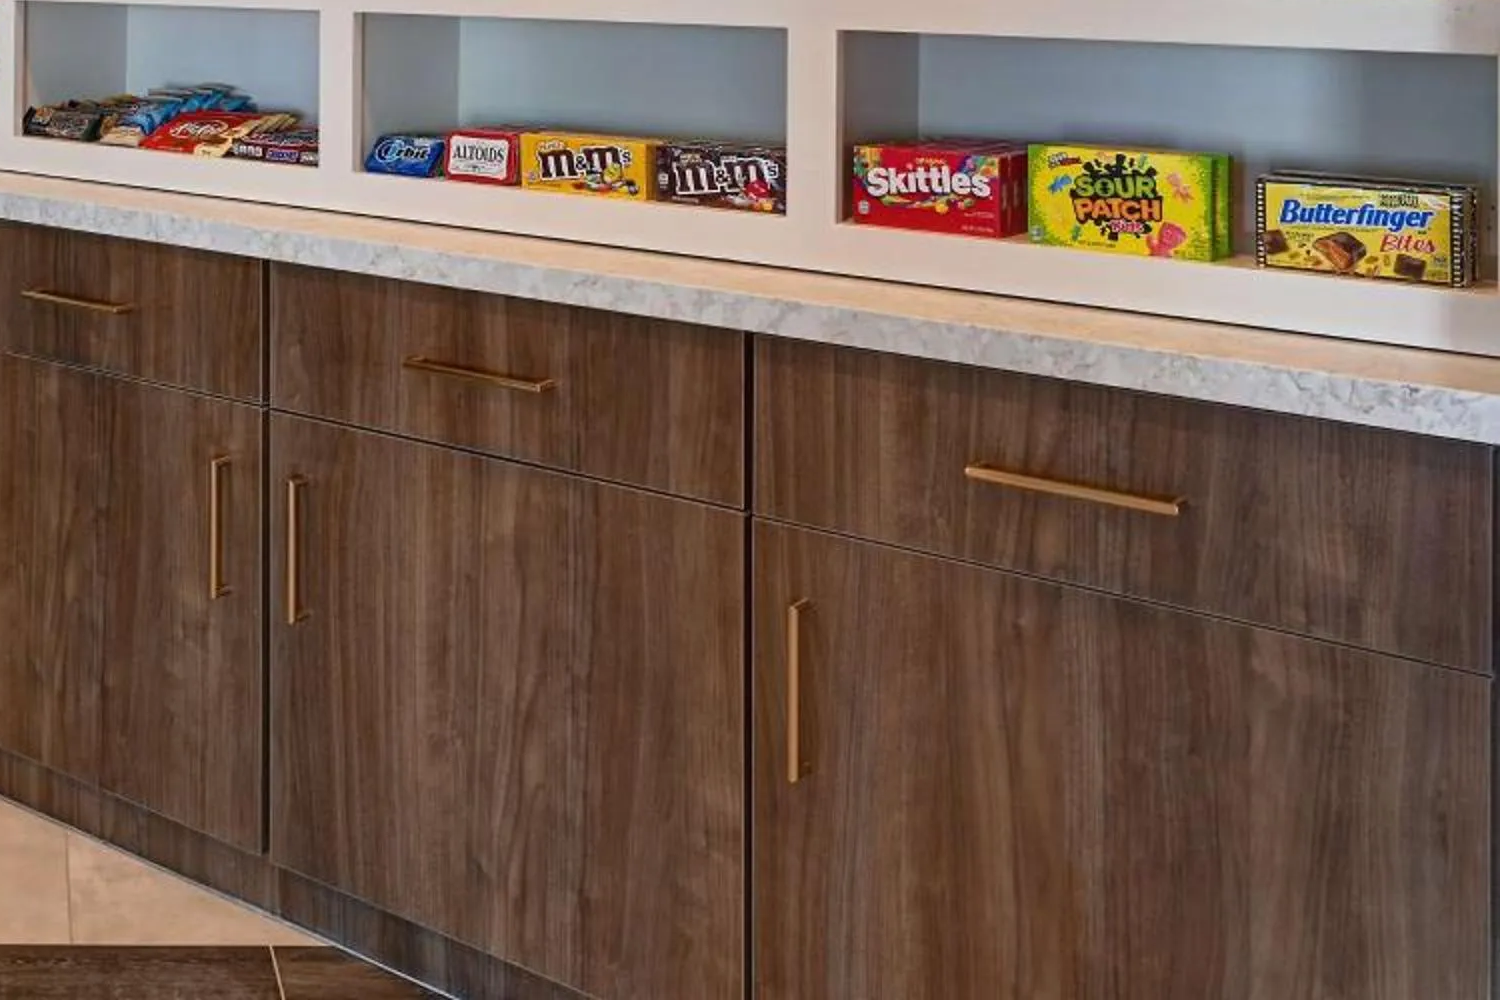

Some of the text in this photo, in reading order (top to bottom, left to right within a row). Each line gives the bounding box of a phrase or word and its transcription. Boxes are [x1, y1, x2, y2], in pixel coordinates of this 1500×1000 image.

[377, 140, 428, 162] Orbit
[453, 143, 505, 163] ALTOIDS
[867, 166, 991, 198] Skittles
[1074, 176, 1156, 198] SOUR
[1075, 197, 1161, 221] PATCH
[1280, 199, 1435, 232] Butterfinger
[1380, 234, 1436, 253] Bites
